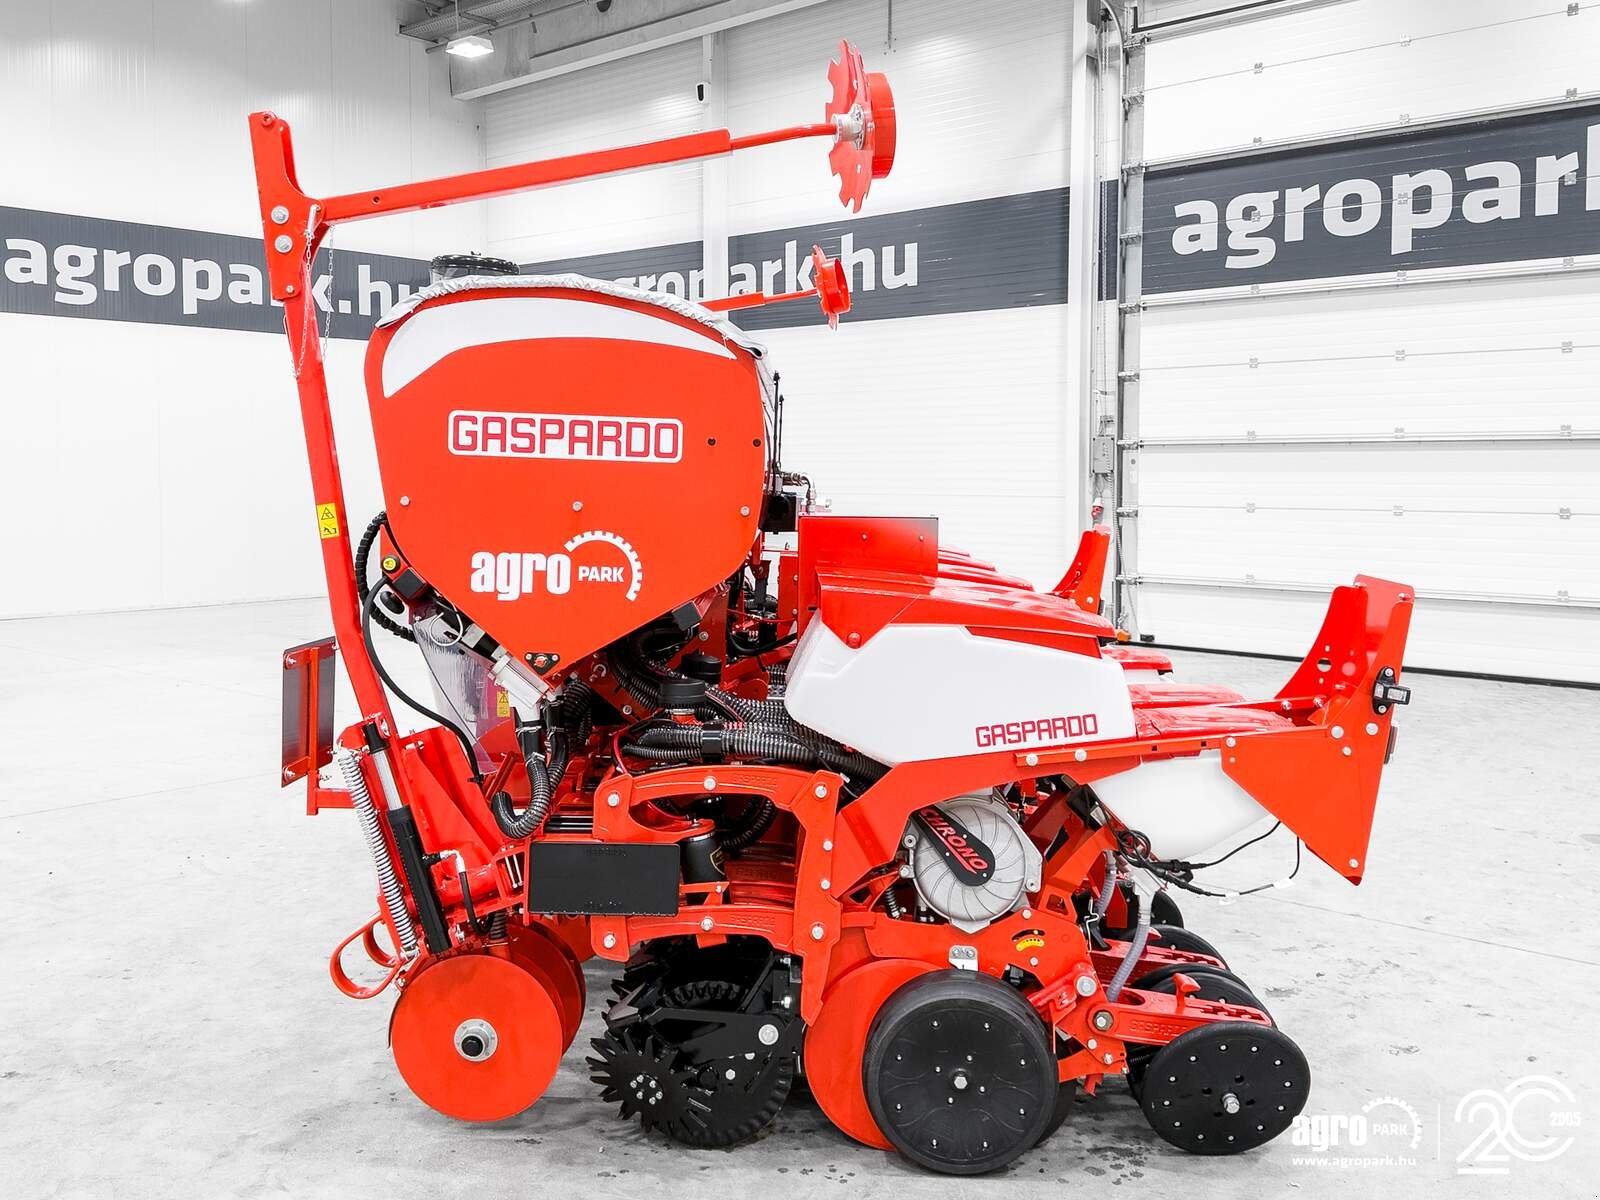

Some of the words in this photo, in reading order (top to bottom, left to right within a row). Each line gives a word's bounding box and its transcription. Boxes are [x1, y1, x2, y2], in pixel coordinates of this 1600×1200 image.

[452, 415, 679, 459] GASPARDO
[470, 551, 571, 601] agro
[578, 565, 625, 583] PARK
[975, 713, 1099, 748] GASPARDO
[920, 808, 988, 870] CHRONO
